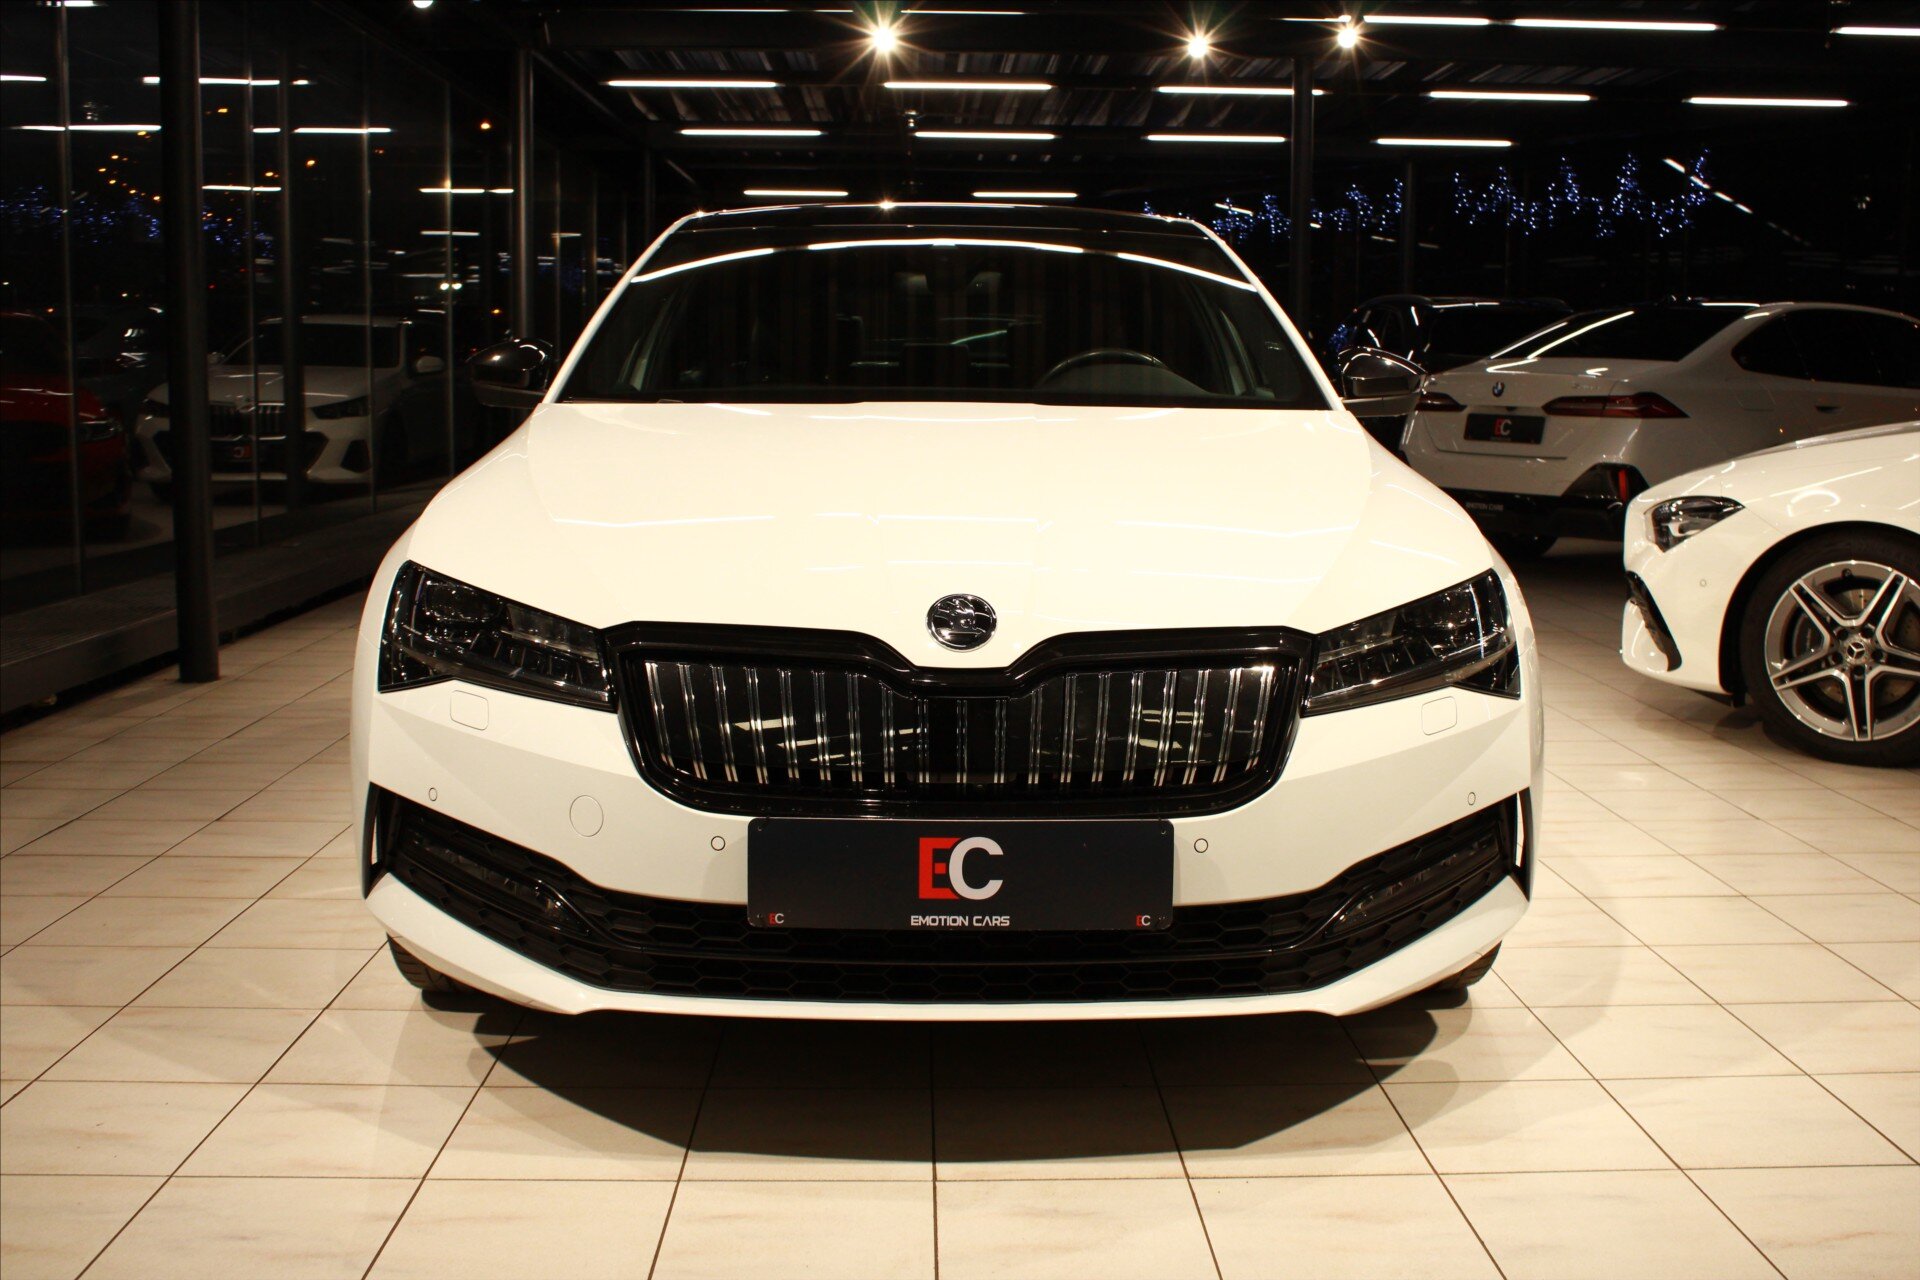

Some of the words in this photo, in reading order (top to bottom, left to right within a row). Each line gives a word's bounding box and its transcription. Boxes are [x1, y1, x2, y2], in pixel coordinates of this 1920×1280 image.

[918, 836, 1004, 900] EC
[910, 915, 969, 927] EMOTION
[972, 915, 1010, 927] CARS
